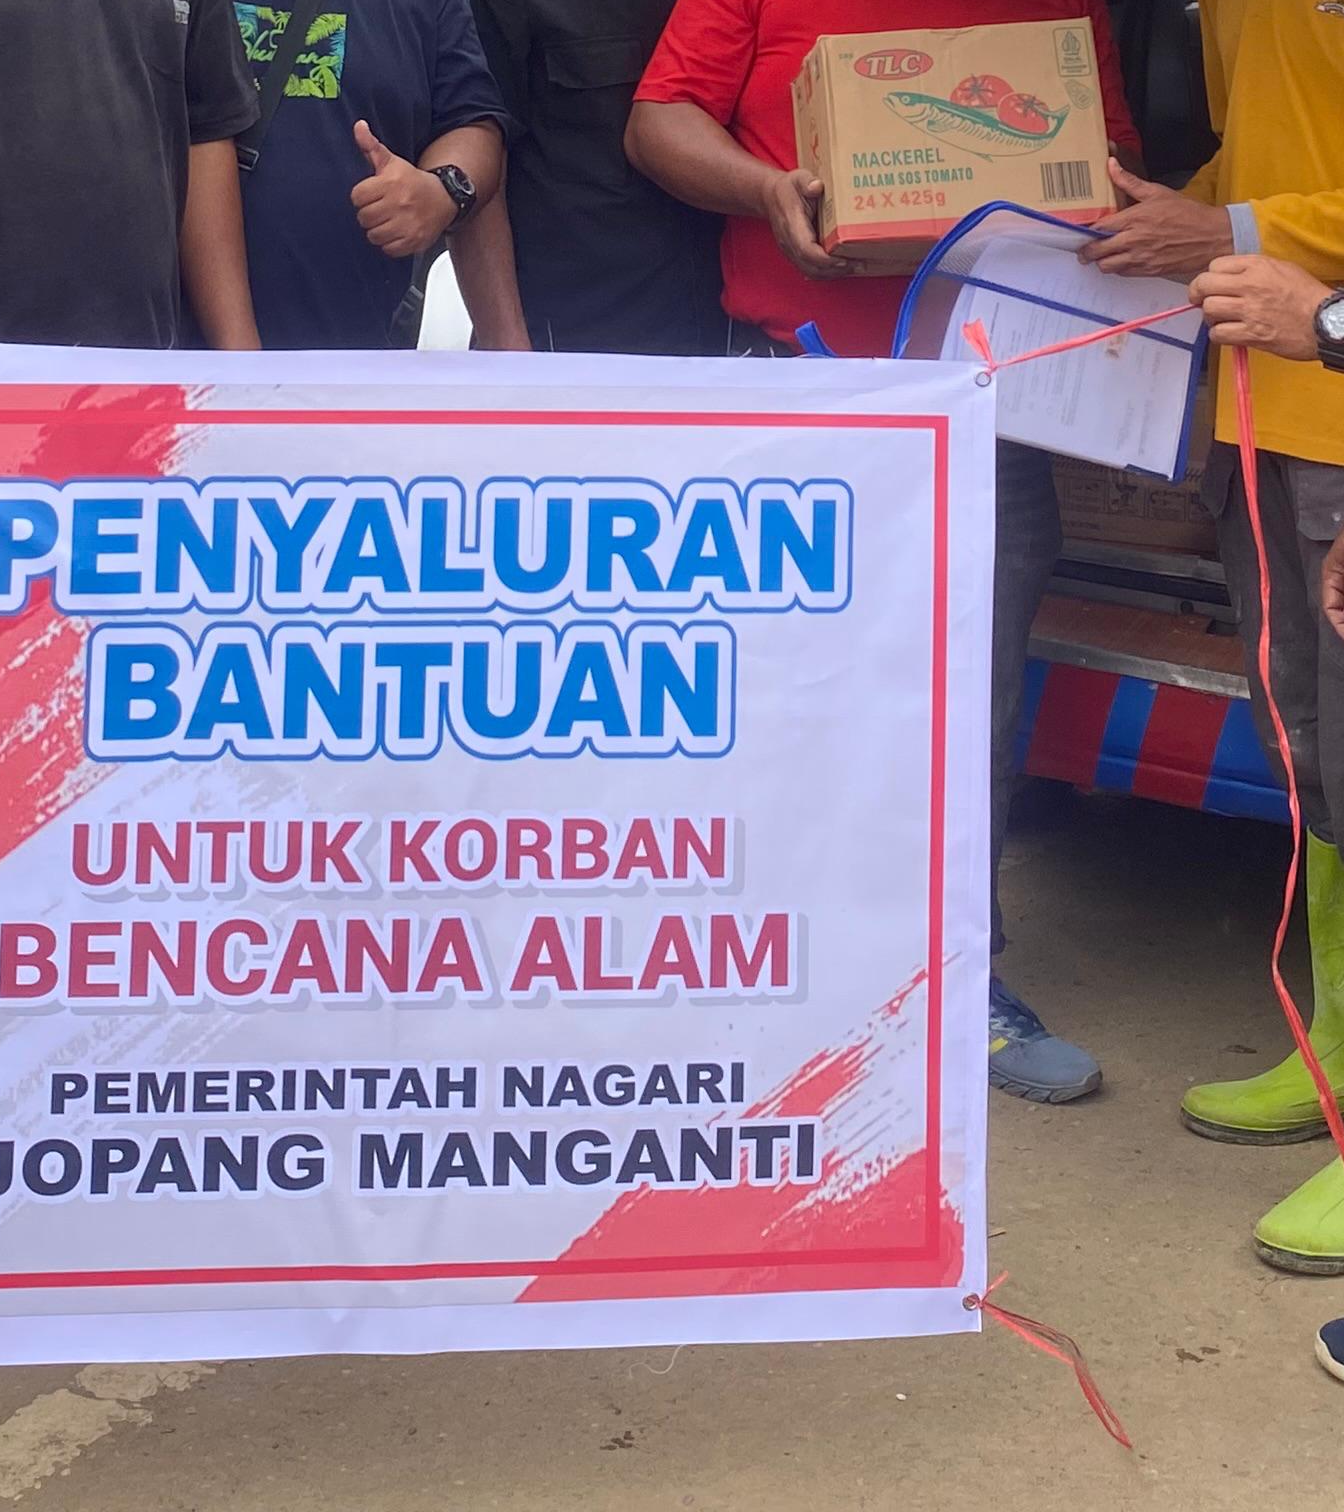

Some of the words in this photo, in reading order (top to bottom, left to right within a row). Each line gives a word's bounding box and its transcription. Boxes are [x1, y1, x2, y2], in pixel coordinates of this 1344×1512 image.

[866, 54, 921, 77] TLC
[852, 148, 945, 169] MACKEREL
[853, 173, 895, 189] DALAM
[898, 170, 921, 185] SOS
[924, 167, 973, 183] TOMATO
[853, 194, 876, 210] 24
[881, 192, 895, 208] X
[900, 189, 946, 207] 425g
[100, 638, 722, 744] BANTUAN
[73, 822, 361, 885] UNTUK
[391, 818, 725, 881] KORBAN
[510, 915, 789, 989] ALAM
[50, 1068, 476, 1114] PEMERINTAH
[503, 1063, 746, 1107] NAGARI
[359, 1125, 815, 1189] MANGANTI
